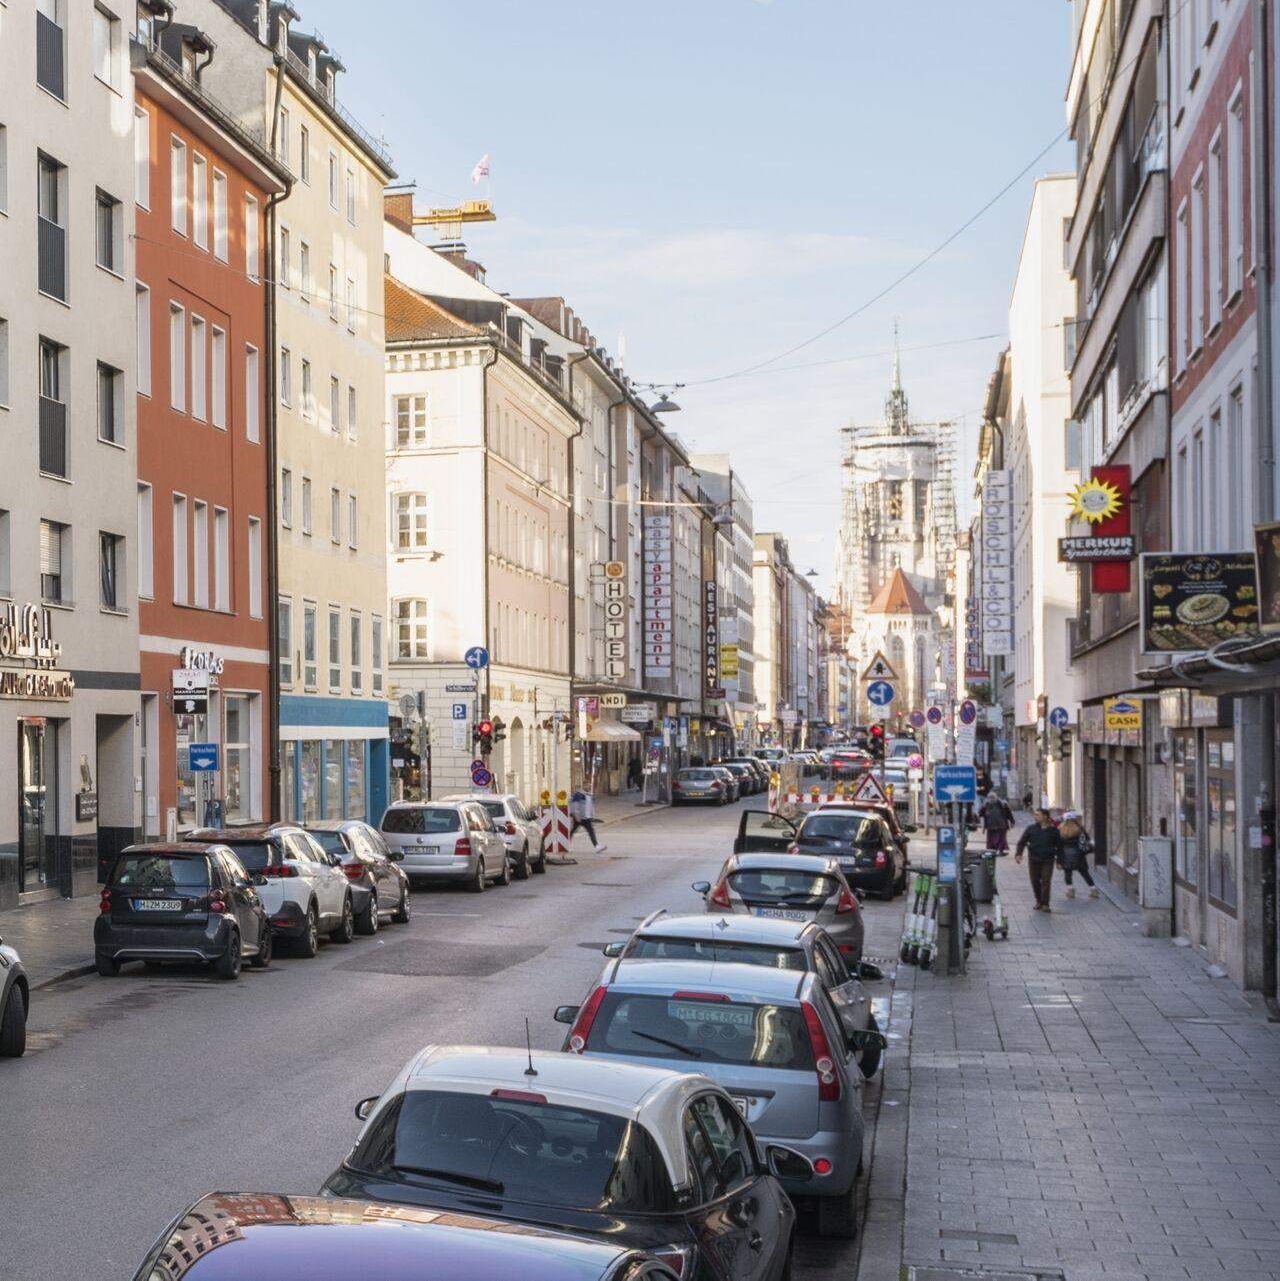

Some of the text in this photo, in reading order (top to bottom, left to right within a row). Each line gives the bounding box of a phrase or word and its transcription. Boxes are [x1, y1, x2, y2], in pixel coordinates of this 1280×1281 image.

[1062, 537, 1133, 549] MERKUR
[607, 583, 622, 676] HOTEL
[706, 582, 717, 687] RESTAURANT
[454, 705, 463, 718] P
[1108, 717, 1139, 725] CASH
[937, 770, 973, 779] Parkschein
[941, 828, 952, 843] P
